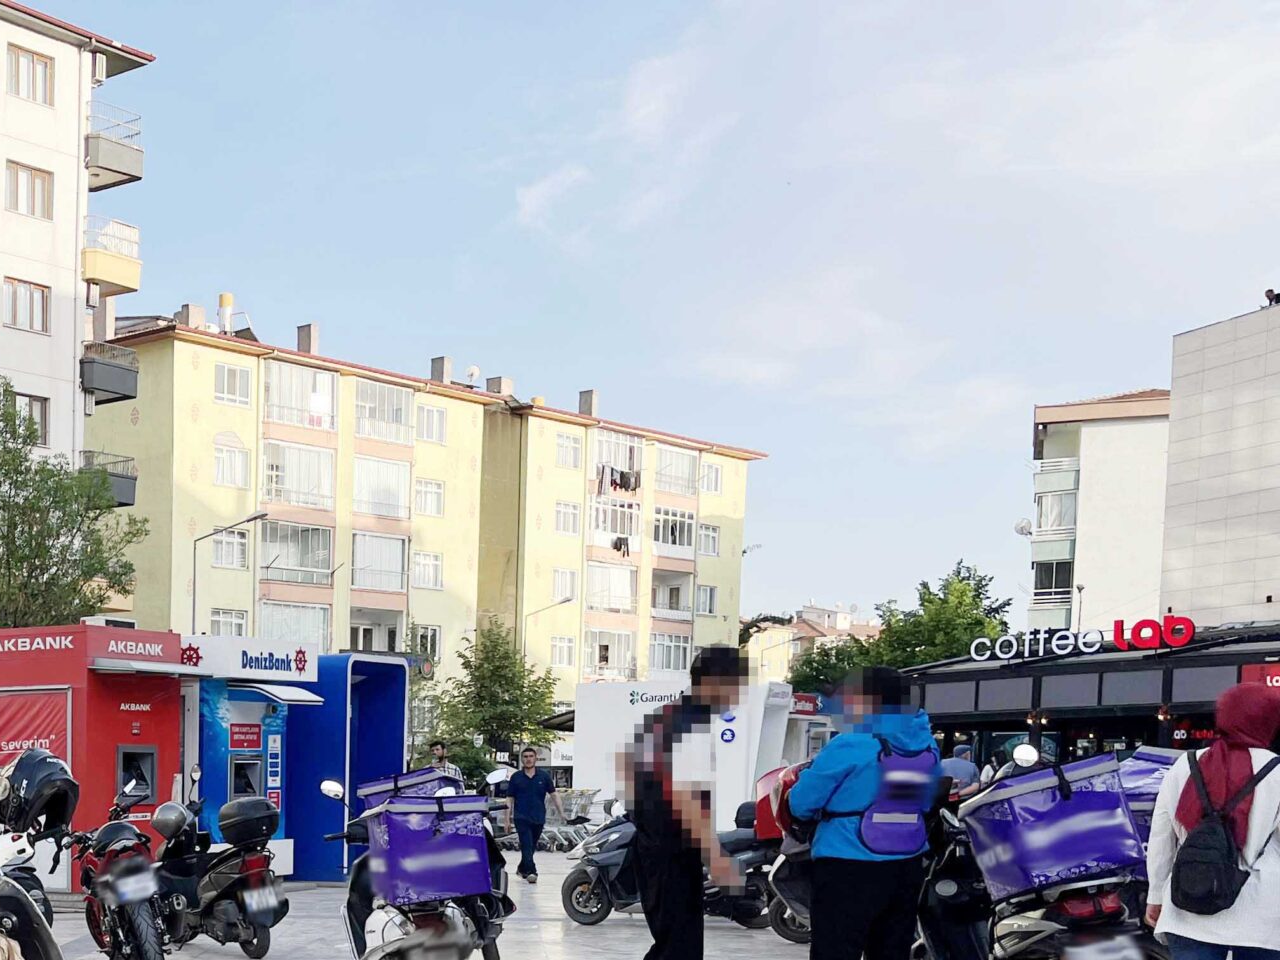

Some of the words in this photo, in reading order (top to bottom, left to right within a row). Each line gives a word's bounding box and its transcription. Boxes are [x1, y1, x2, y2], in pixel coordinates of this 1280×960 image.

[108, 640, 163, 656] AKBANK
[970, 628, 1104, 661] coffee
[241, 650, 292, 672] DenizBank
[120, 703, 151, 712] AKBANK
